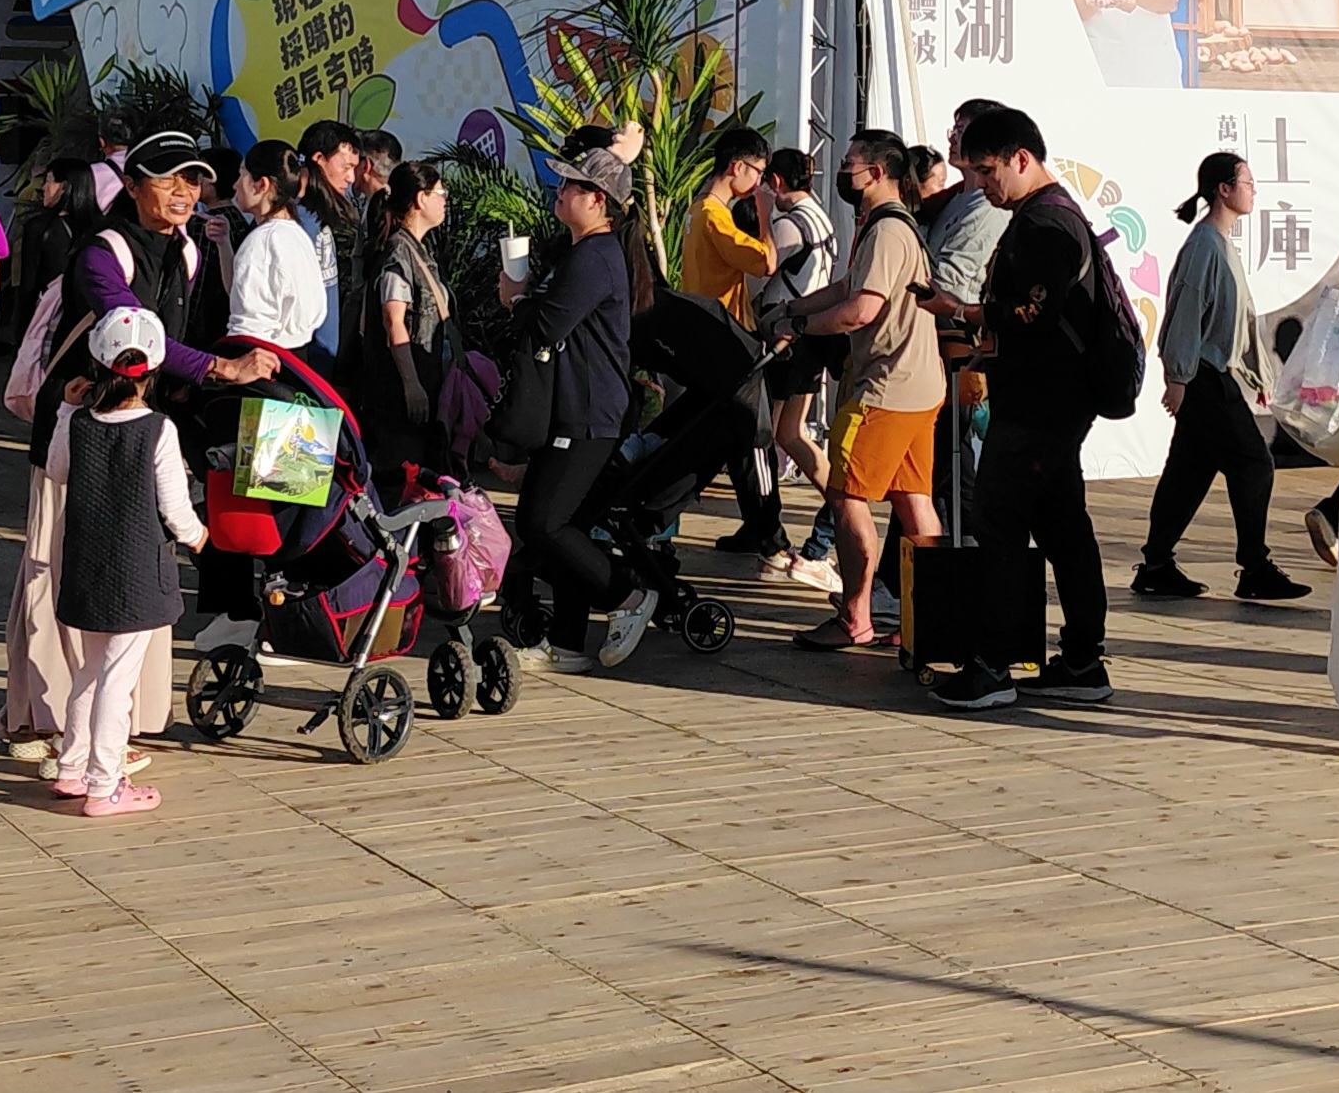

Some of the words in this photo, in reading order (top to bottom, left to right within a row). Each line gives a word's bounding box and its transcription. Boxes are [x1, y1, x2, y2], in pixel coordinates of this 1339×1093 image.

[279, 1, 354, 71] 採購的
[1256, 117, 1313, 273] 土庫
